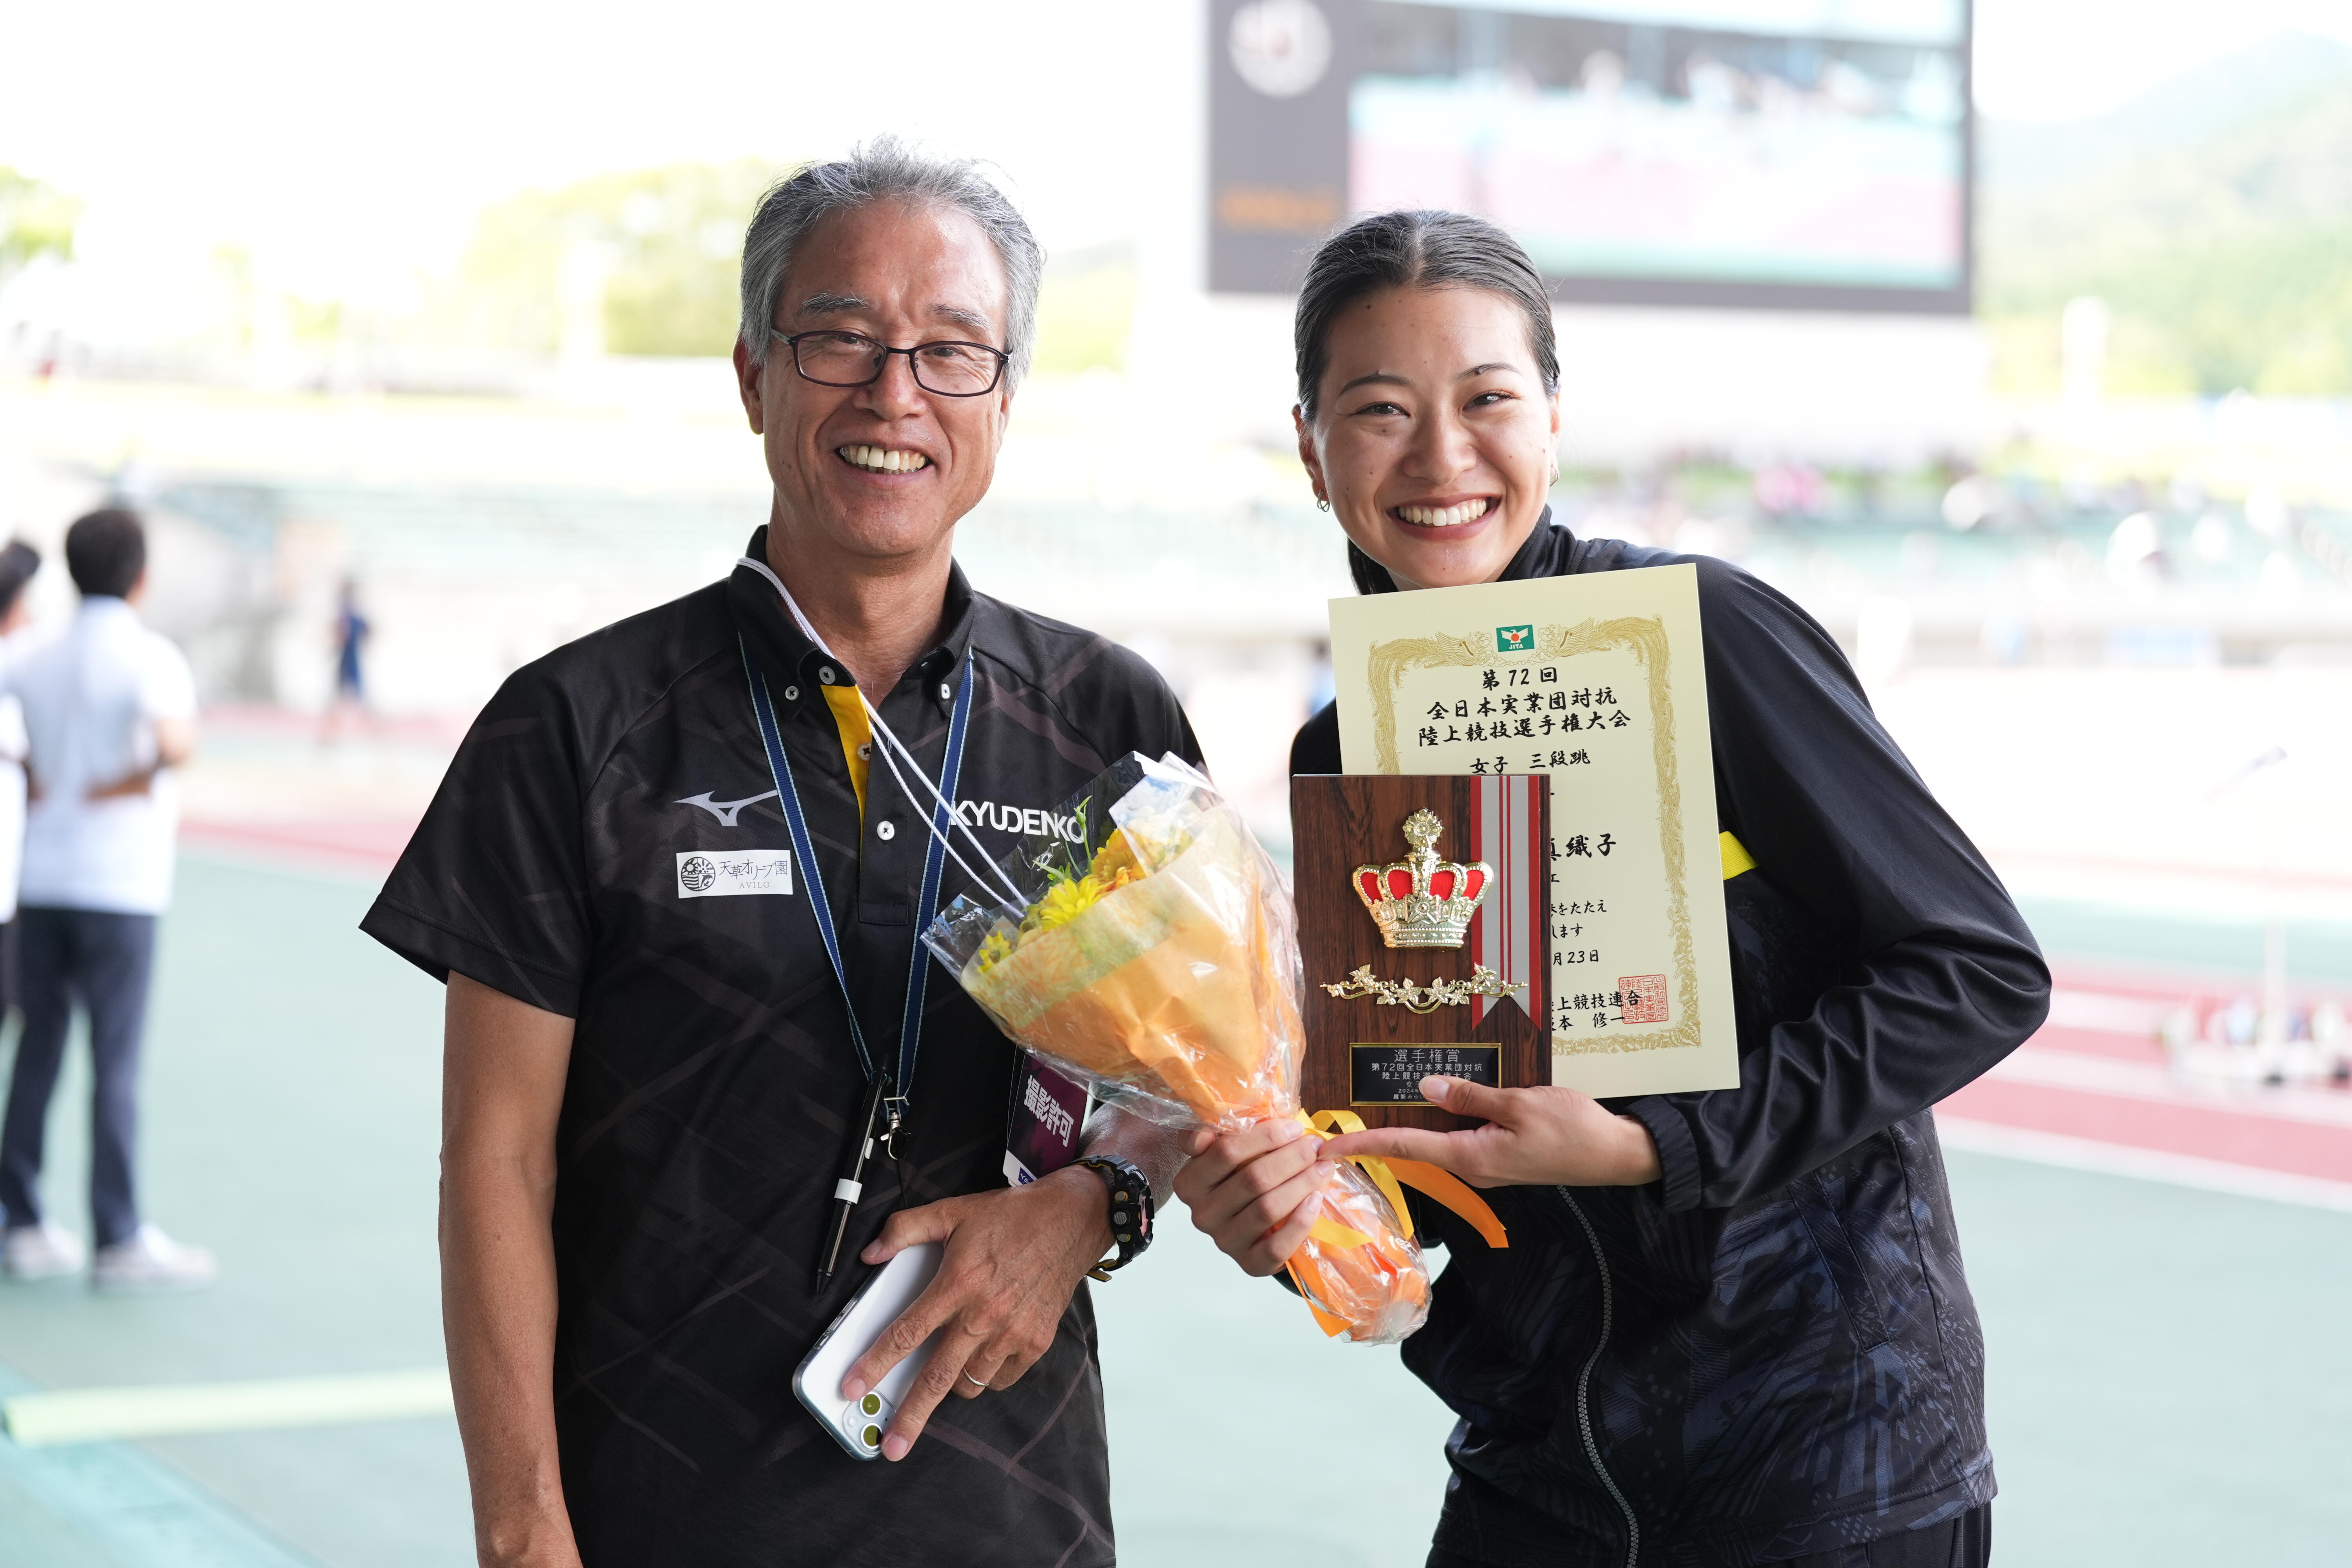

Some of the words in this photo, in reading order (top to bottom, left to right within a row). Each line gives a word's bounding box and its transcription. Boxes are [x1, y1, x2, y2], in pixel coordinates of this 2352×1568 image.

[1483, 667, 1557, 690] 第72回
[1427, 687, 1617, 720] 全日本実業団対抗
[1419, 710, 1631, 747] 陸上競技選手権大会
[1469, 756, 1508, 774] 女子
[1529, 749, 1590, 768] 三段跳
[950, 800, 1086, 844] KYUDENKO
[719, 858, 787, 880] 天草オリーブ園
[1553, 949, 1598, 965] 月23日
[1552, 990, 1642, 1011] 上競技連合
[1592, 1012, 1625, 1028] 修一
[1394, 1049, 1459, 1062] 選手権賞
[1372, 1063, 1483, 1071] 第72回全日本実業団対抗
[1024, 1075, 1074, 1147] 撮影許可
